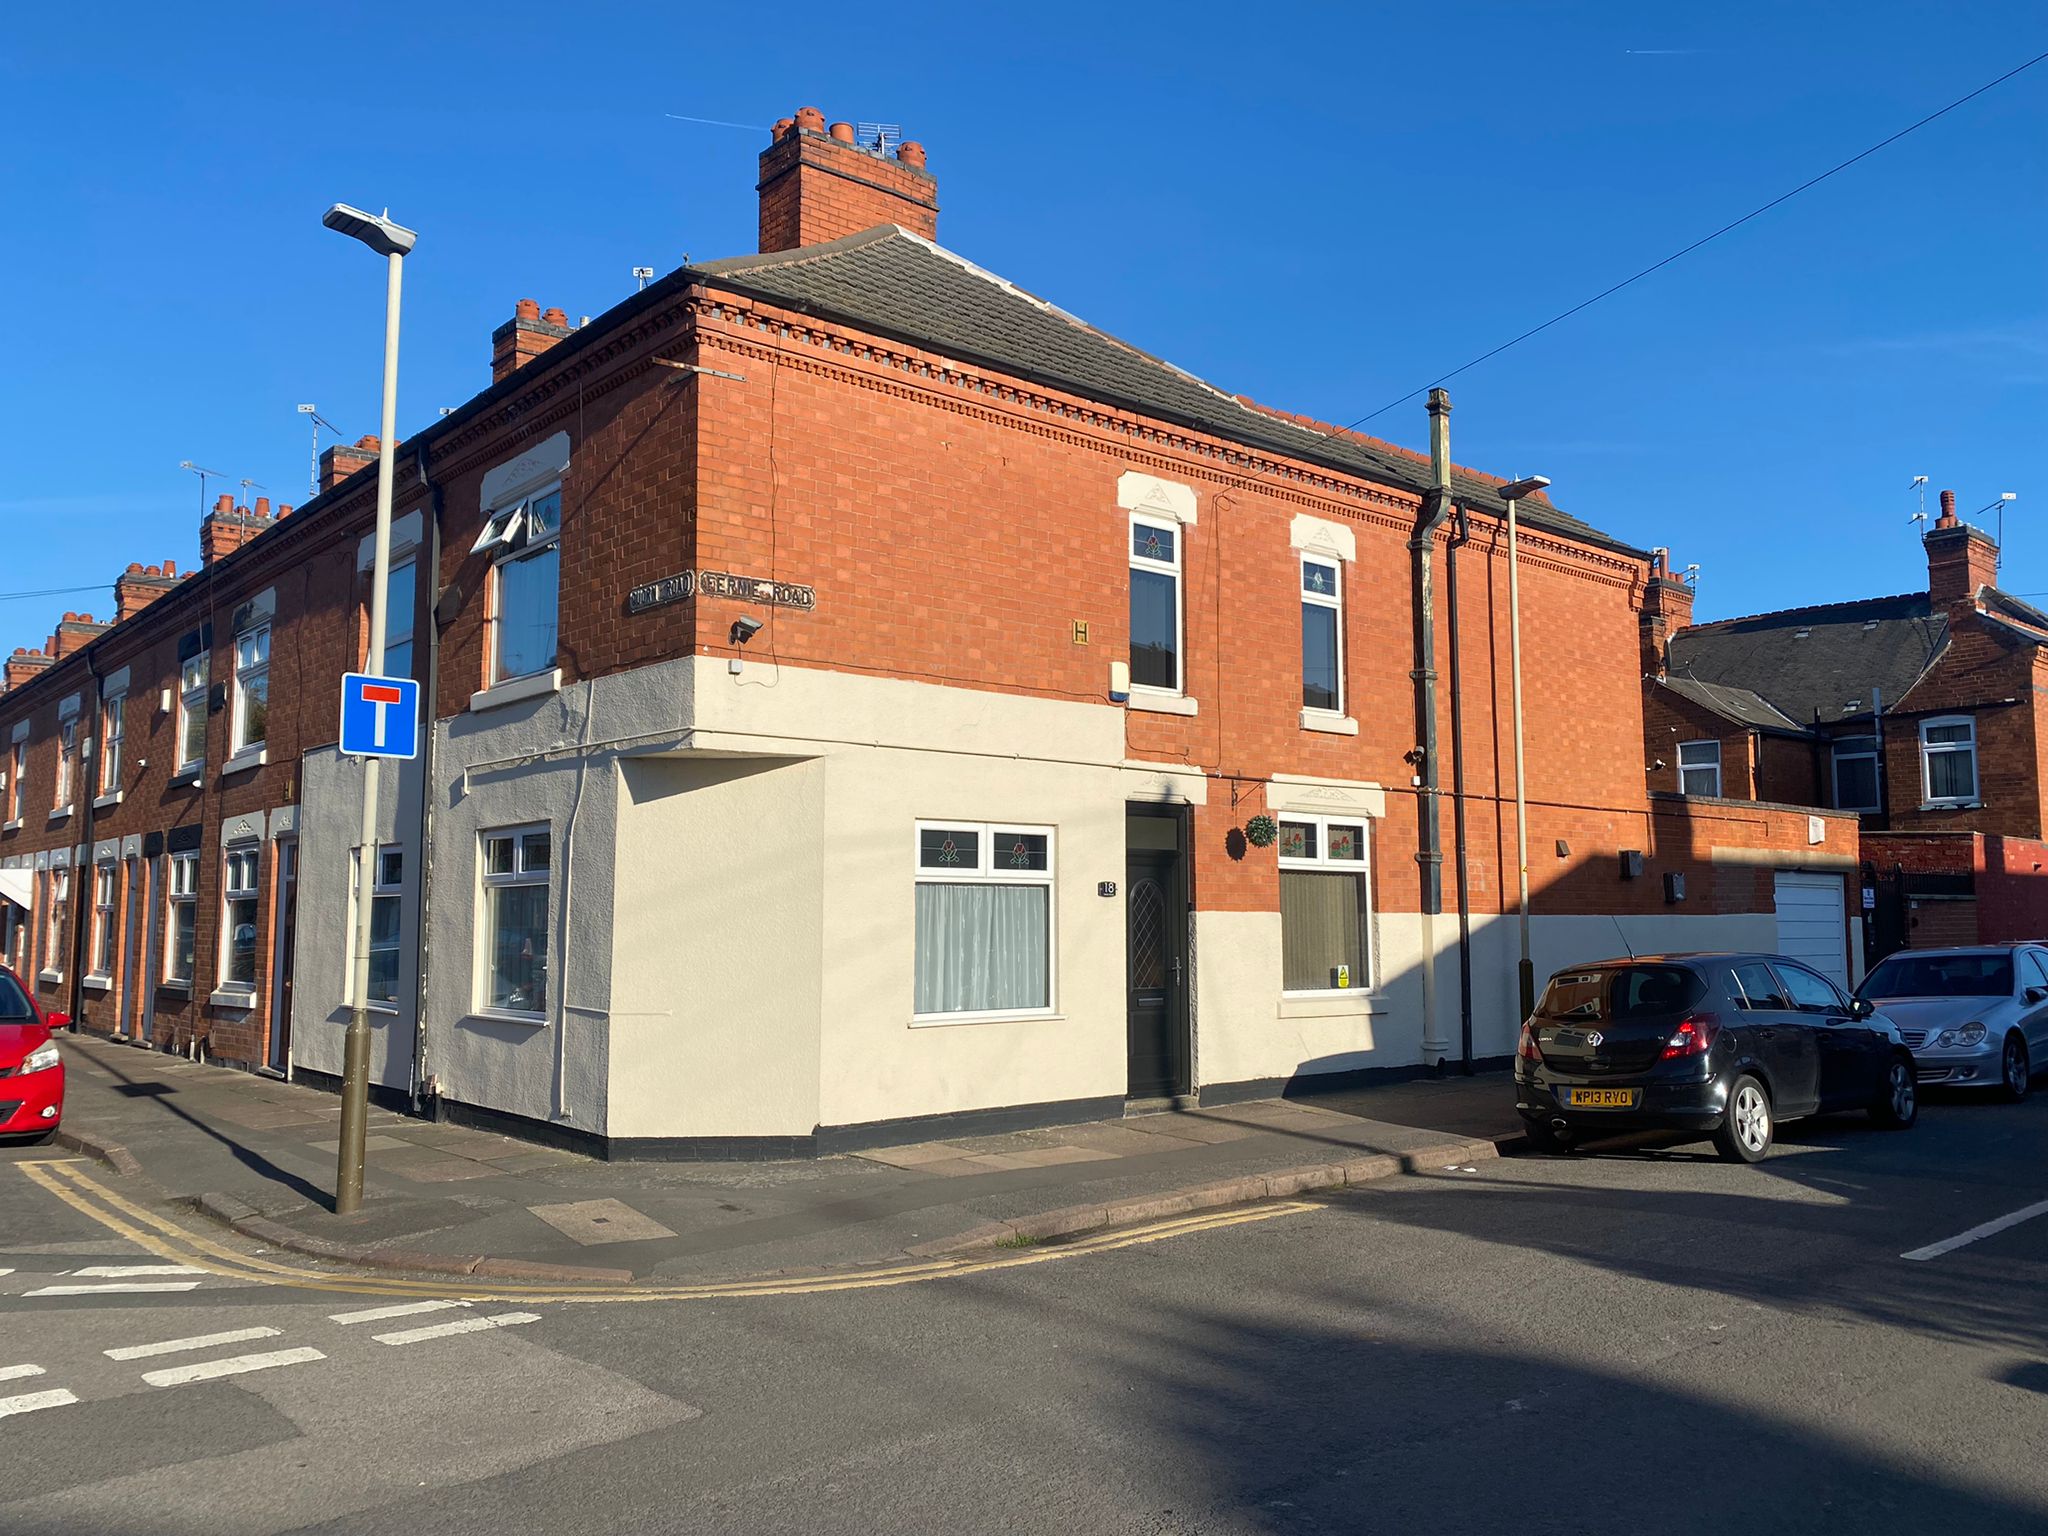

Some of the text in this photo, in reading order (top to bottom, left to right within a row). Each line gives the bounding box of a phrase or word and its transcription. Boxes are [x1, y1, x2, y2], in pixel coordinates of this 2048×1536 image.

[667, 575, 690, 596] ROAD
[706, 574, 812, 605] FERNIE ROAD
[1075, 621, 1087, 643] H
[1104, 882, 1115, 893] 18
